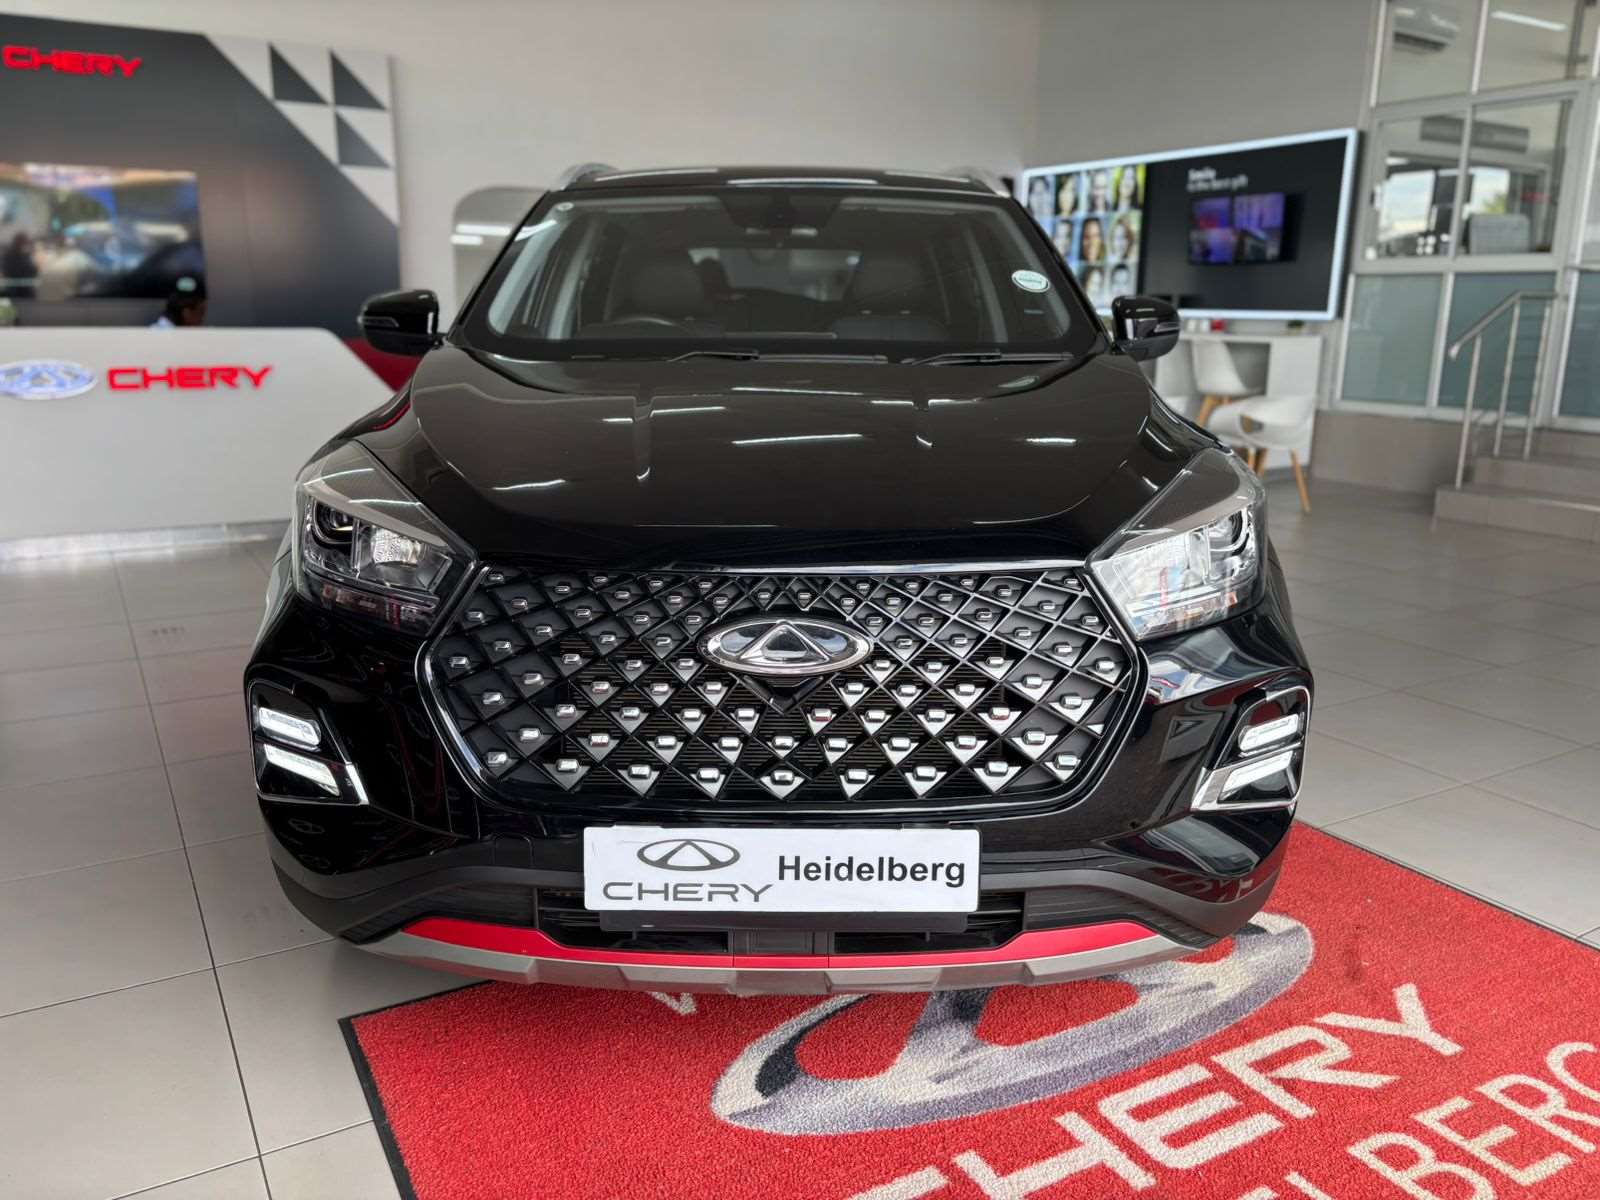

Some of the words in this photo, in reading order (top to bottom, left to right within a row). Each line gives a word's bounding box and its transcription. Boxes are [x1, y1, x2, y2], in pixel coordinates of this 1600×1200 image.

[2, 45, 142, 78] CHERY
[107, 365, 273, 392] CHERY
[778, 855, 965, 888] Heidelberg
[602, 881, 774, 903] CHERY
